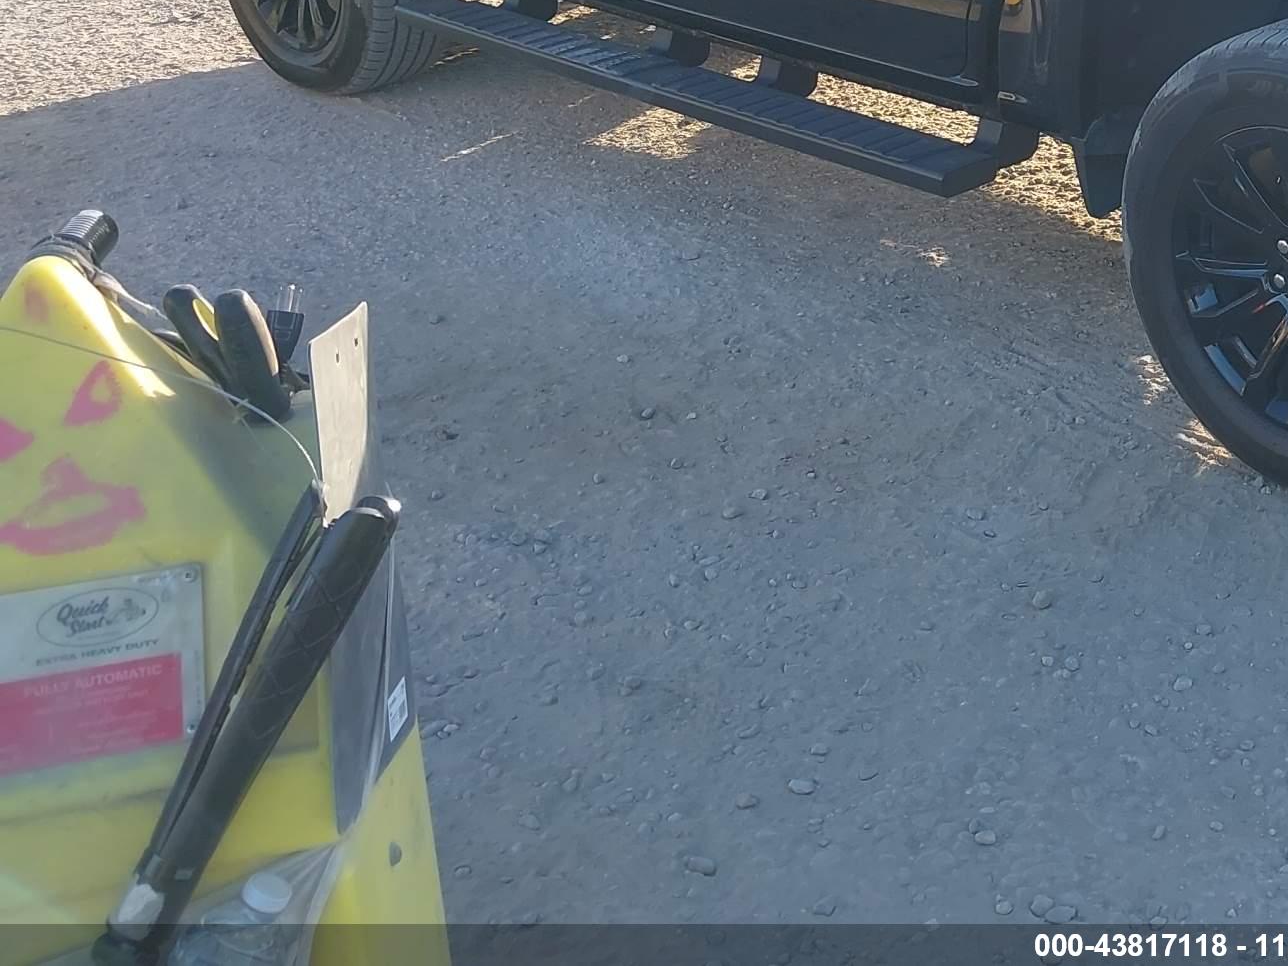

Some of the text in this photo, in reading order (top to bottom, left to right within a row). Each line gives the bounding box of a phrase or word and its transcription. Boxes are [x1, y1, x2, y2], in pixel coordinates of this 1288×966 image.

[56, 596, 110, 626] Quick
[35, 638, 160, 667] EXTRA HEAVY DUTY
[23, 681, 69, 698] FULLY
[75, 665, 162, 689] AUTOMATIC
